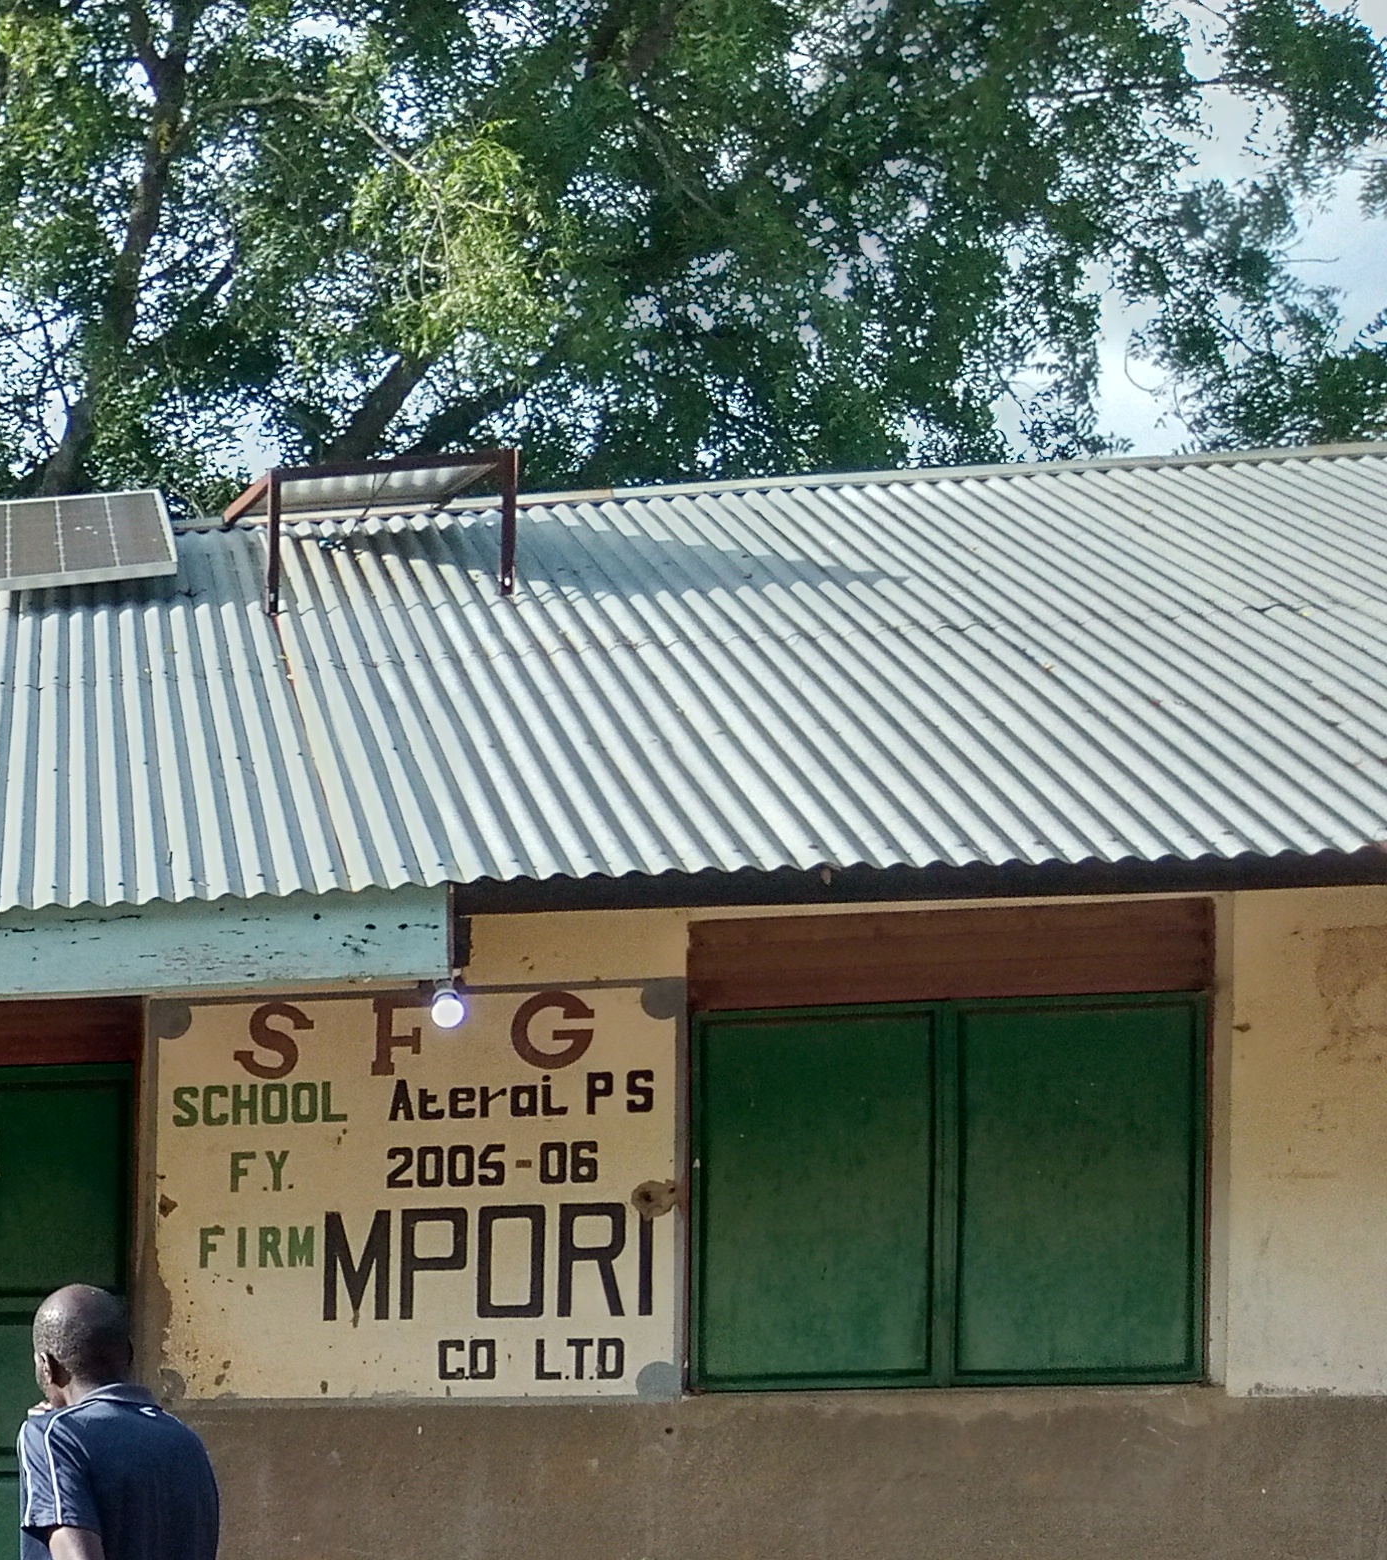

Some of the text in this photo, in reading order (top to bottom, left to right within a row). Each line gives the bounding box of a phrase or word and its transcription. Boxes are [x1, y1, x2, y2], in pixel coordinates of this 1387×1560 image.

[173, 1081, 348, 1128] SCHOOL
[388, 1074, 568, 1121] Aterai
[386, 1141, 599, 1189] 2005-06
[199, 1202, 654, 1322] FIRM MPORI
